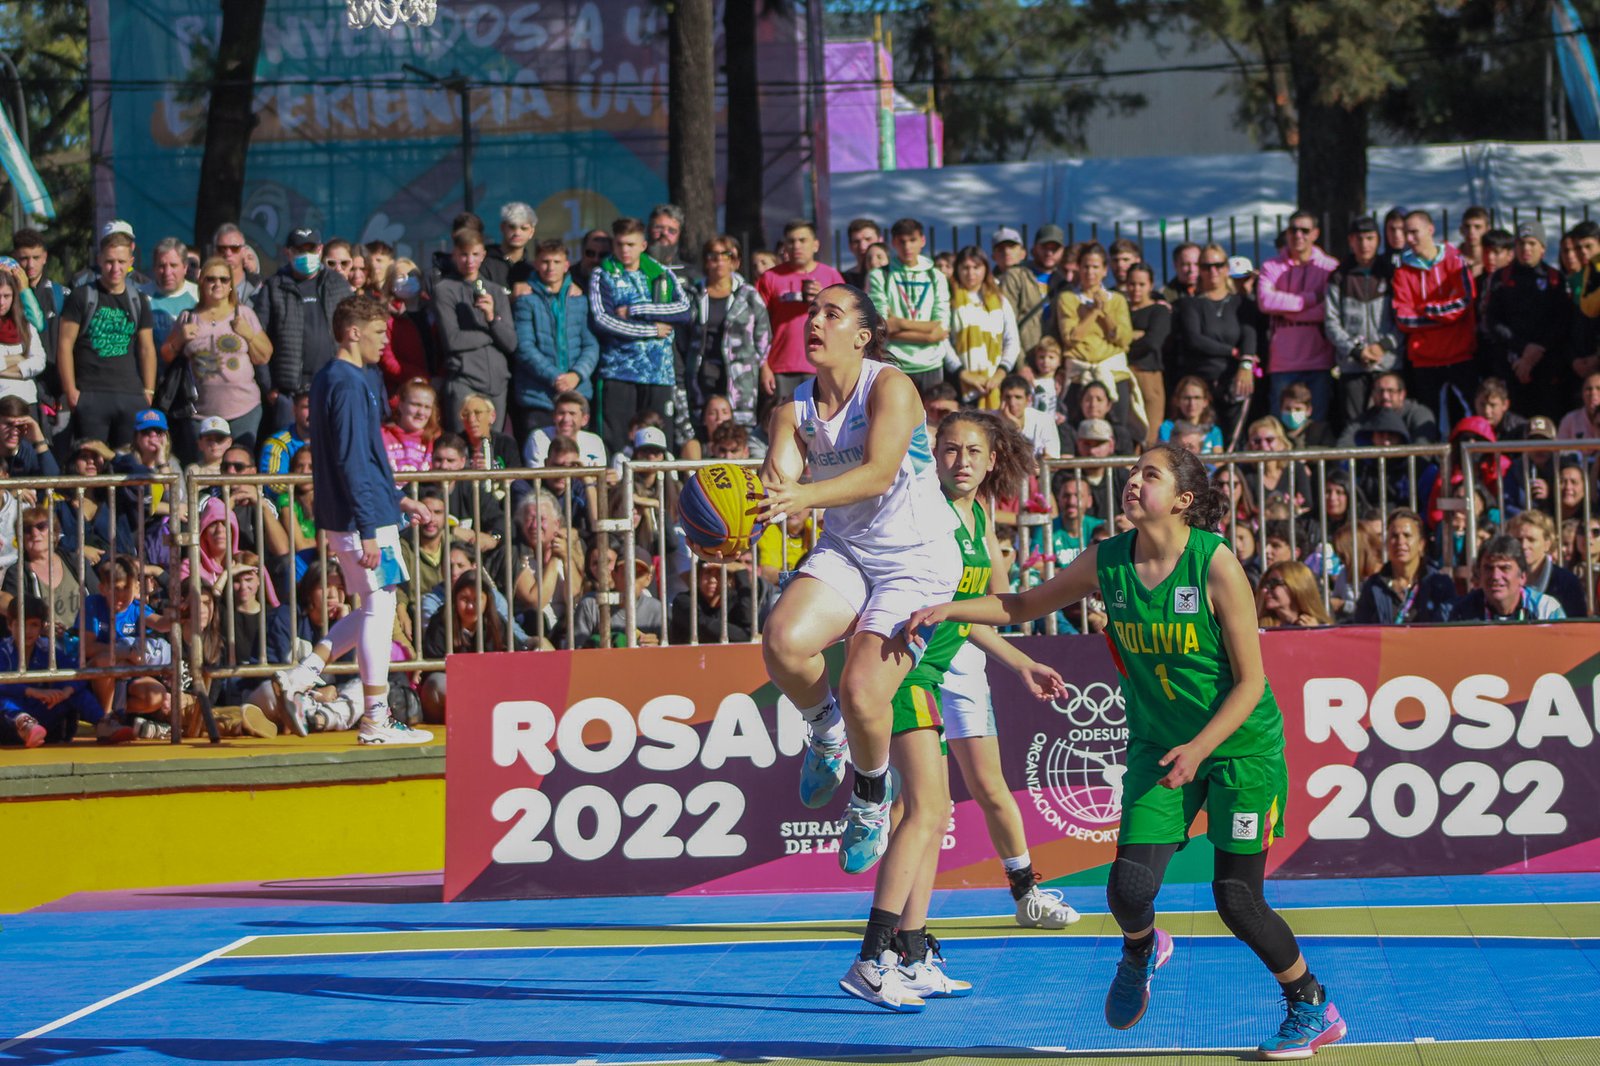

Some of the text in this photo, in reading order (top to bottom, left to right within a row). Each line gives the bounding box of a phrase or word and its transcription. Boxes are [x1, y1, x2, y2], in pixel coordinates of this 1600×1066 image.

[163, 68, 553, 137] EERIENCIA
[807, 444, 864, 466] AGENTIN
[1114, 621, 1199, 655] BOLIVIA
[1154, 663, 1176, 701] 1
[1069, 728, 1129, 741] ODESUR
[1303, 673, 1600, 752] ROSA
[1026, 732, 1120, 843] ORGANIZACION DEPORT
[1306, 759, 1568, 840] 2022
[491, 781, 748, 864] 2022
[785, 838, 840, 854] DE LA
